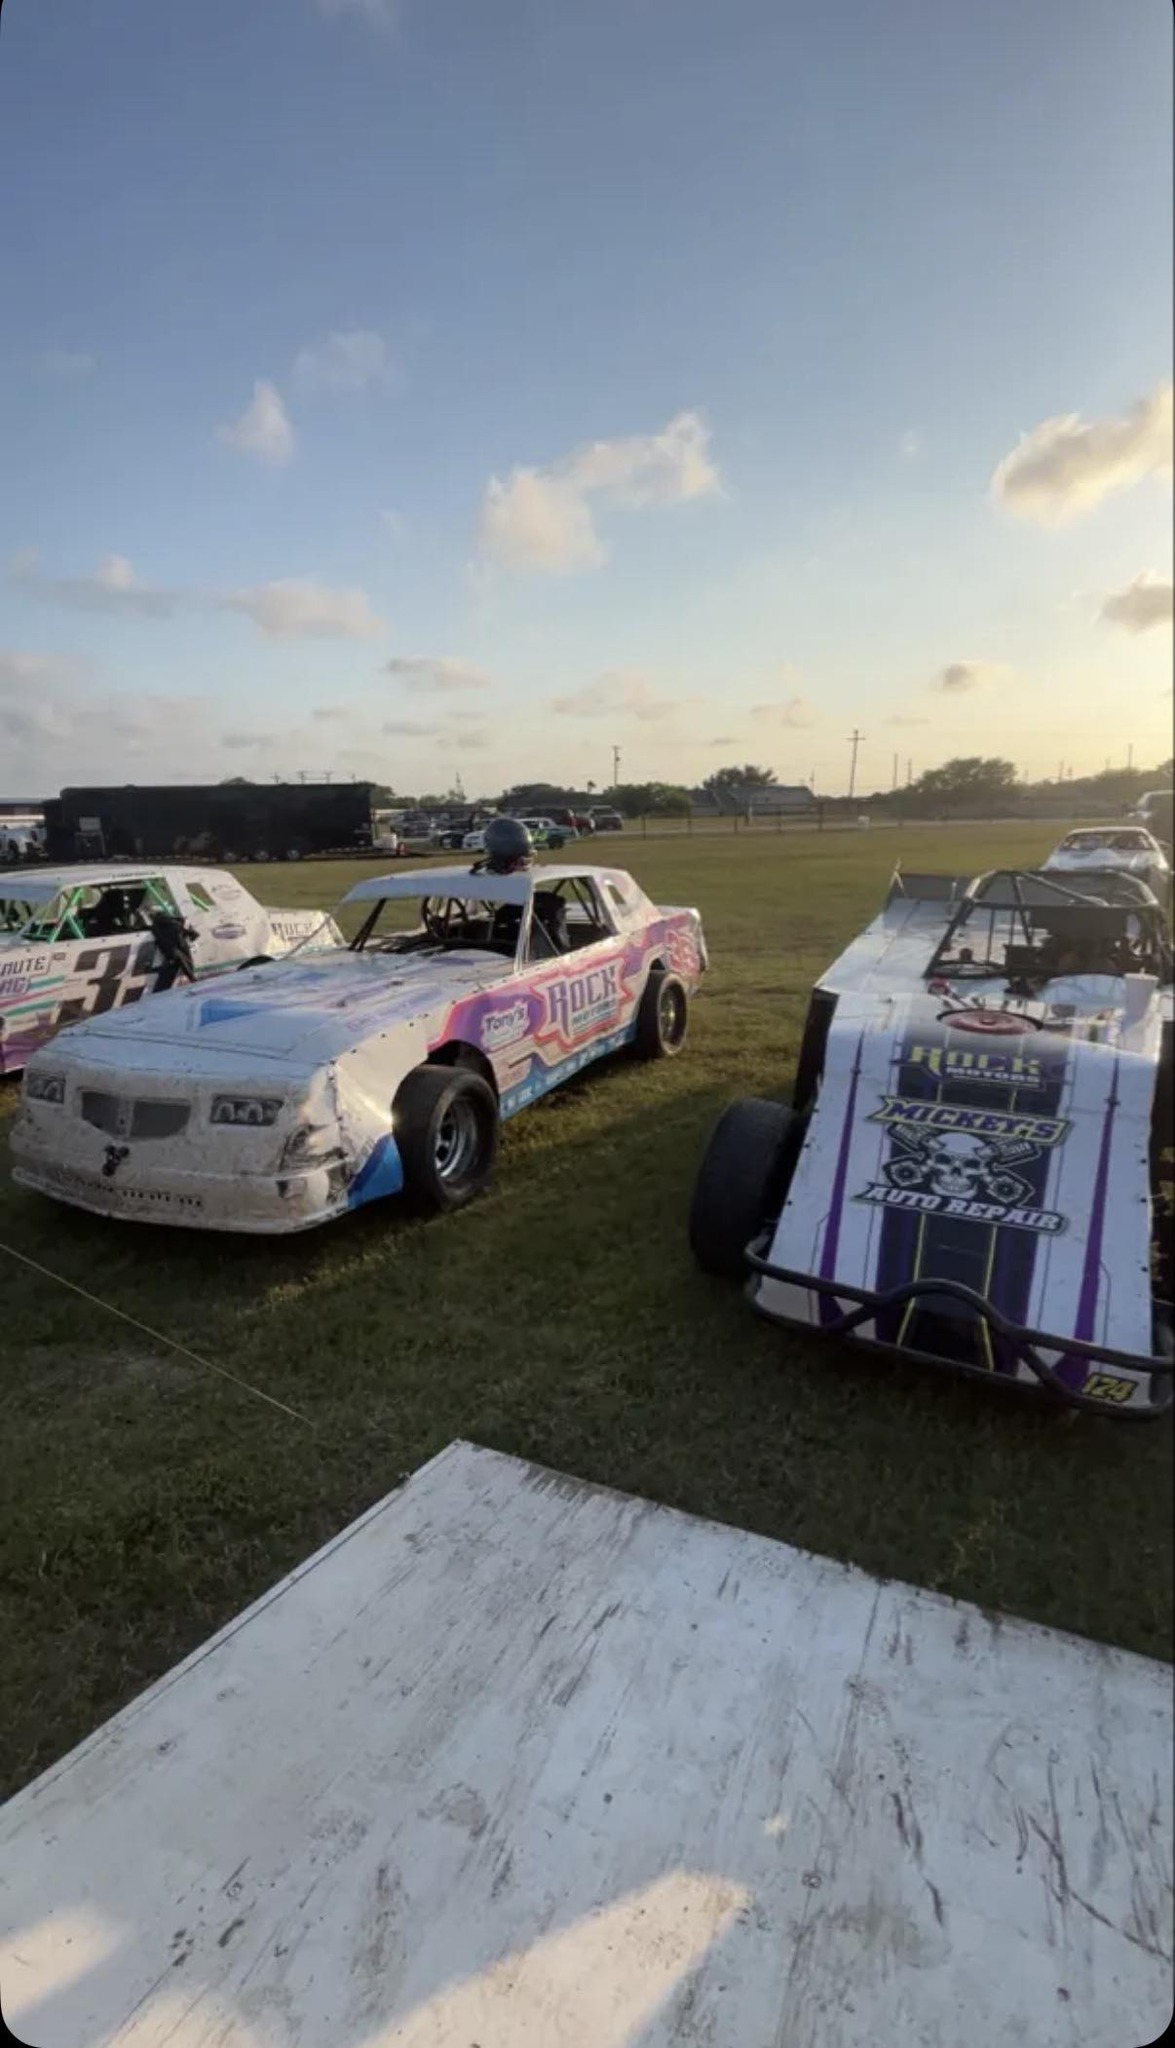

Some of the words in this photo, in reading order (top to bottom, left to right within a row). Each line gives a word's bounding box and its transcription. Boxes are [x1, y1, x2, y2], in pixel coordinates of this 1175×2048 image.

[547, 965, 616, 1037] ROCK
[909, 1046, 1041, 1077] ROCK
[947, 1066, 1041, 1083] MOTORS
[888, 1102, 1060, 1138] MICKEY'S
[866, 1186, 942, 1209] AUTO
[944, 1198, 1062, 1231] REPAIR
